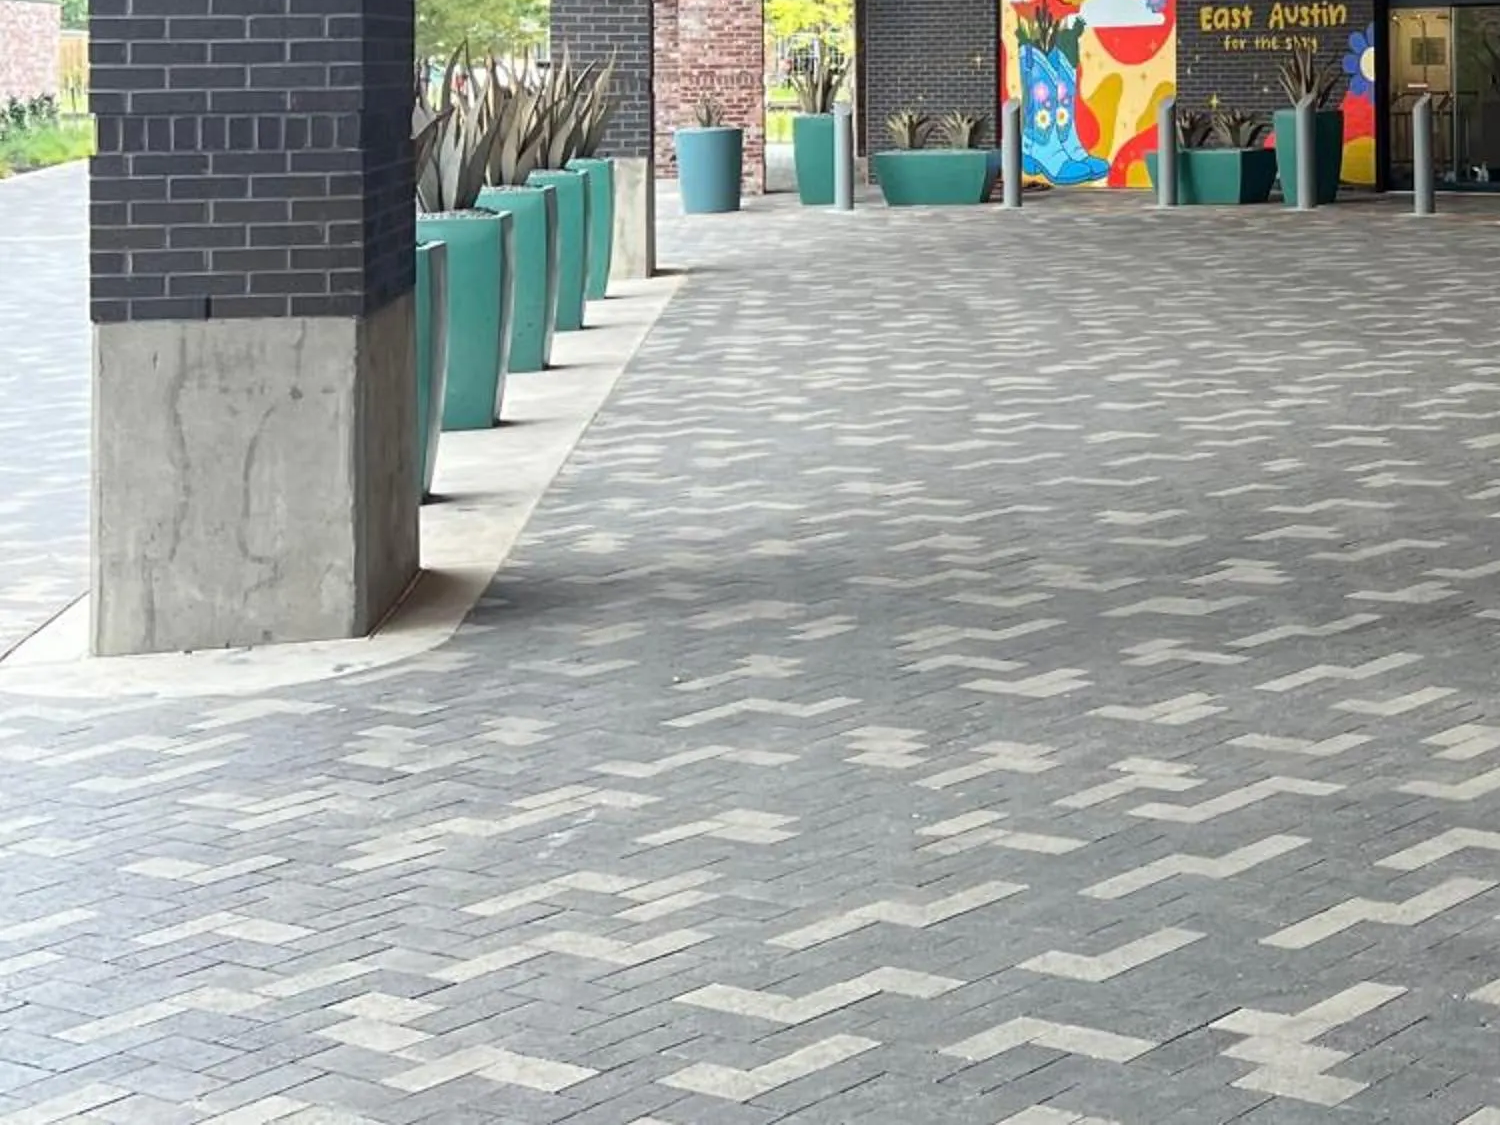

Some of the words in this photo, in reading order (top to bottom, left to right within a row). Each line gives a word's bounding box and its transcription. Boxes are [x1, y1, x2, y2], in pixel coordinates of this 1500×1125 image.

[1200, 4, 1252, 31] East
[1269, 0, 1347, 30] Austin
[1224, 35, 1247, 51] for
[1255, 35, 1280, 50] the
